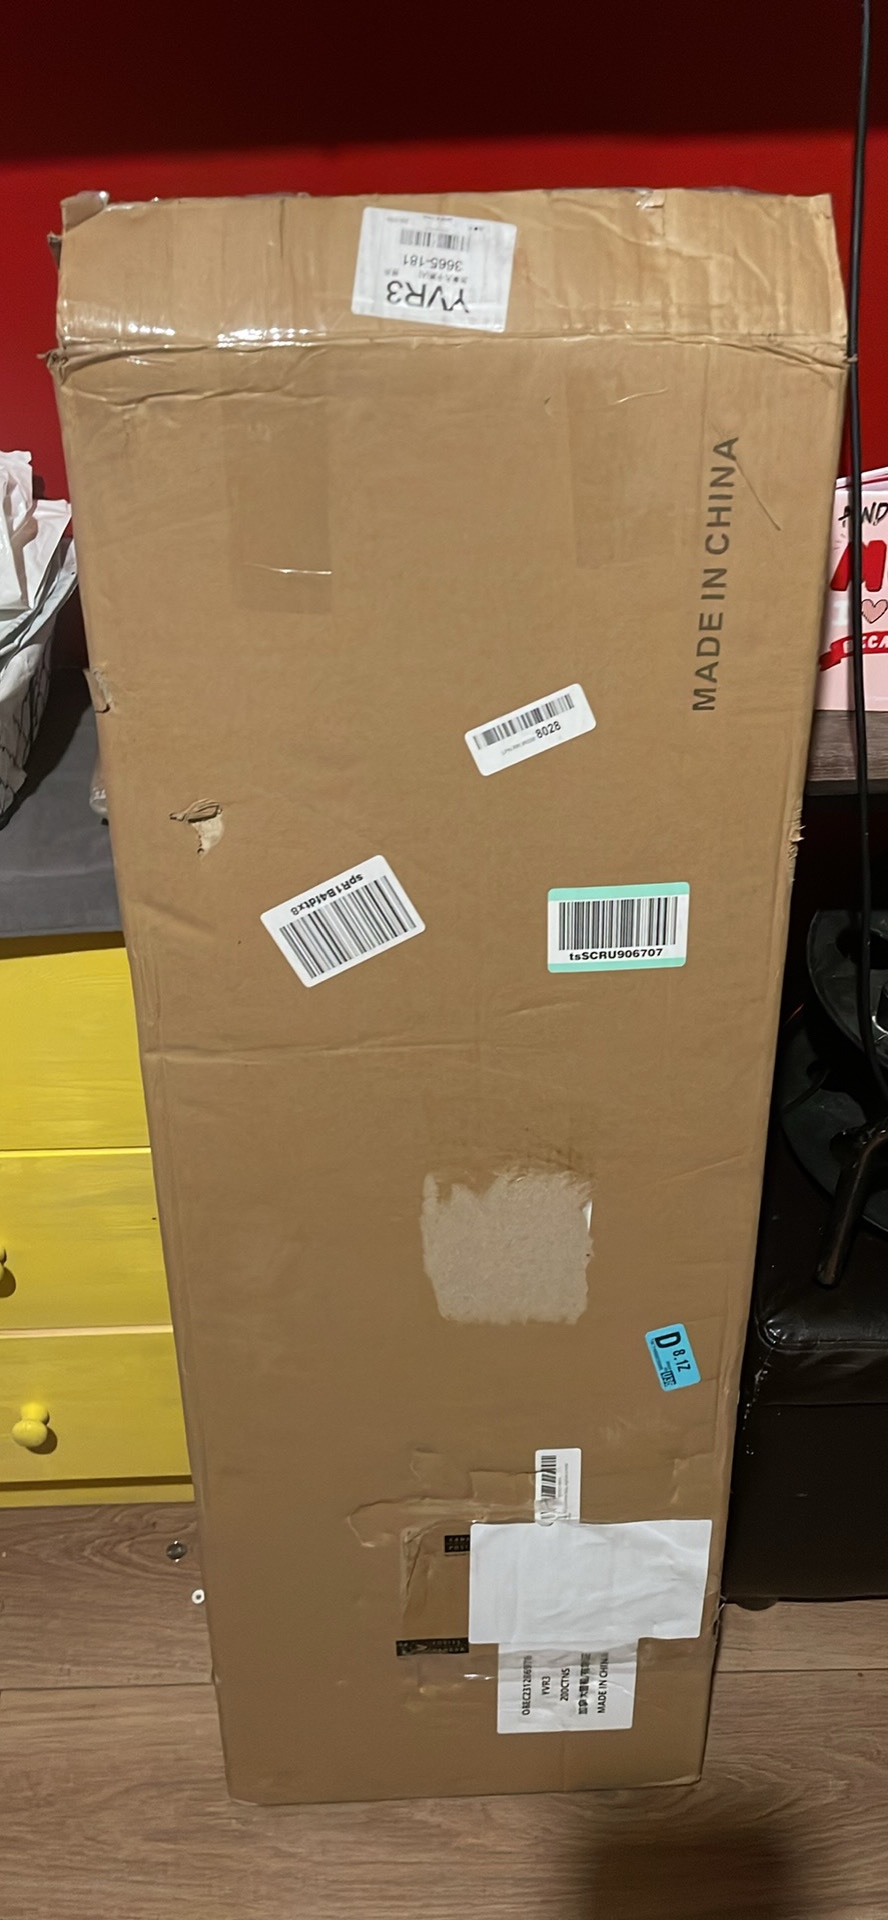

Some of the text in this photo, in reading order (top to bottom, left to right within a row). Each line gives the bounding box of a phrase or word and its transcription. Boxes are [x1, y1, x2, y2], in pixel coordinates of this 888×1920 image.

[403, 254, 463, 272] 3665-181
[386, 280, 470, 313] YVR3
[692, 437, 739, 711] MADE IN CHINA
[535, 720, 561, 739] 8028
[290, 873, 364, 916] spR1B4fdtx8
[569, 948, 663, 961] tsSCRU906707
[654, 1331, 682, 1348] D
[541, 1675, 551, 1695] YVR3
[598, 1679, 608, 1689] IN
[597, 1690, 608, 1714] MADE
